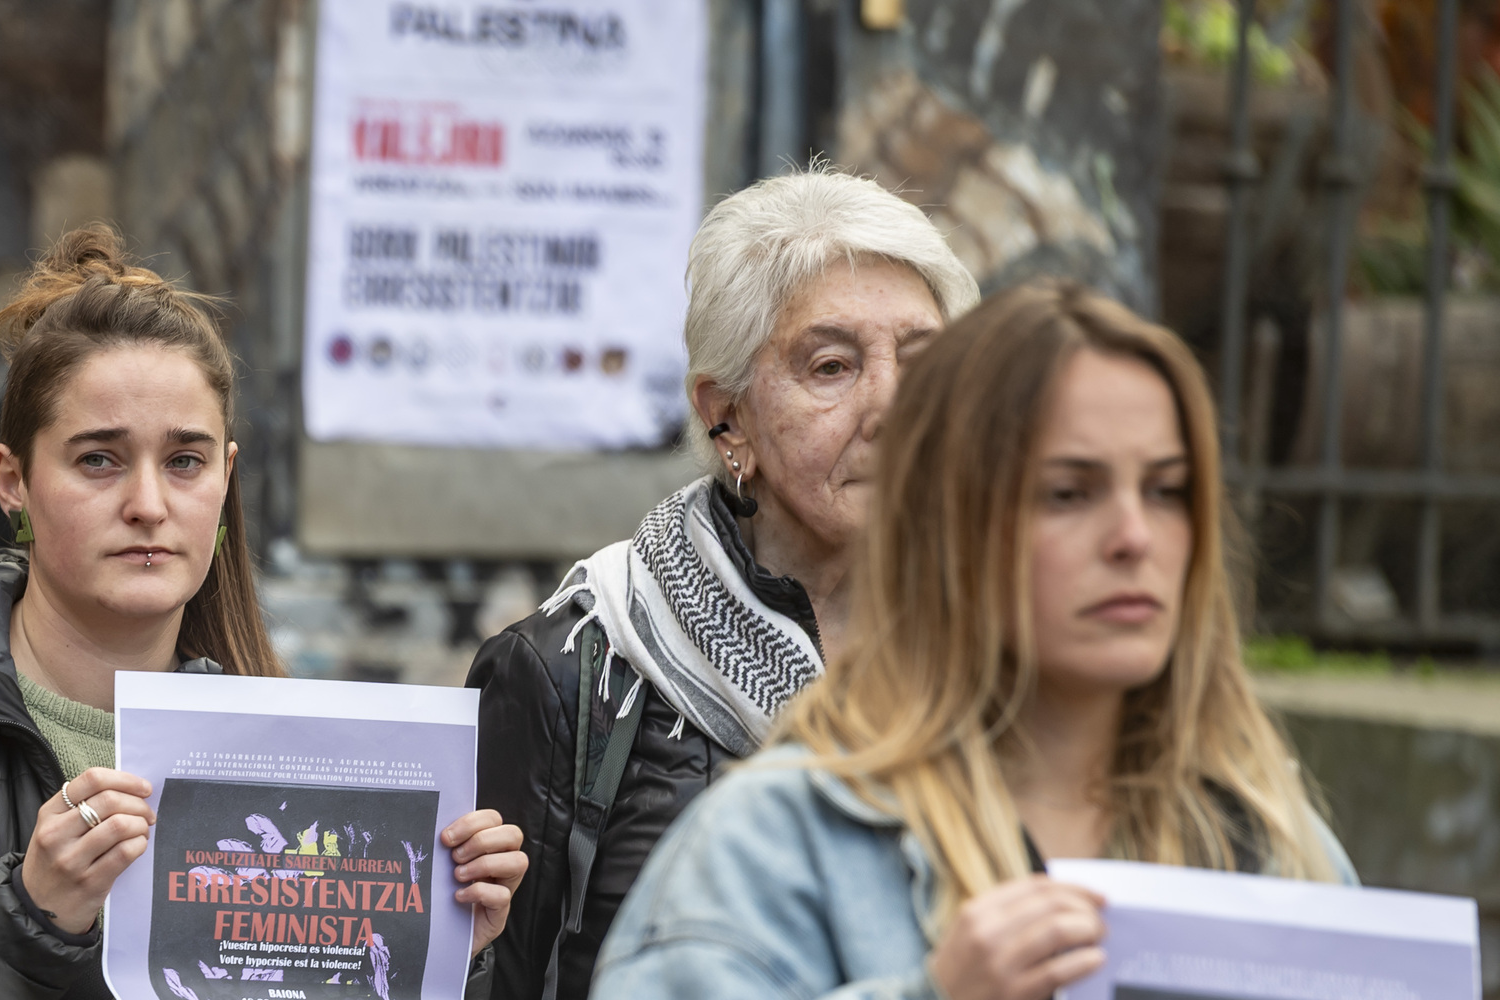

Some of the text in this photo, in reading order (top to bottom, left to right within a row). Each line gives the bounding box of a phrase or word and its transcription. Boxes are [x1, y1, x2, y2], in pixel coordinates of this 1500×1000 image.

[214, 753, 273, 761] INDARKERIA
[280, 756, 333, 764] MATXISTEN
[340, 759, 385, 767] AURKAKO
[391, 761, 422, 769] EGUNA
[214, 762, 275, 770] INTERNACIONAL
[335, 766, 383, 775] VIOLENCIAS
[387, 770, 433, 778] MACHISTAS
[218, 770, 271, 778] INTERNATIONALE
[360, 776, 396, 785] VIOLENCES
[398, 779, 435, 787] MACHISTES
[185, 850, 402, 874] KONPLIZITATE SAREEN AURREAN
[168, 871, 424, 913] ERRESISTENTZIA
[213, 910, 375, 947] FEMINISTA
[219, 940, 366, 956] ¡Vuestra hipocresía es violencia!
[219, 954, 362, 970] Votre hypocrisie est la violence!
[268, 988, 306, 1000] BAIONA
